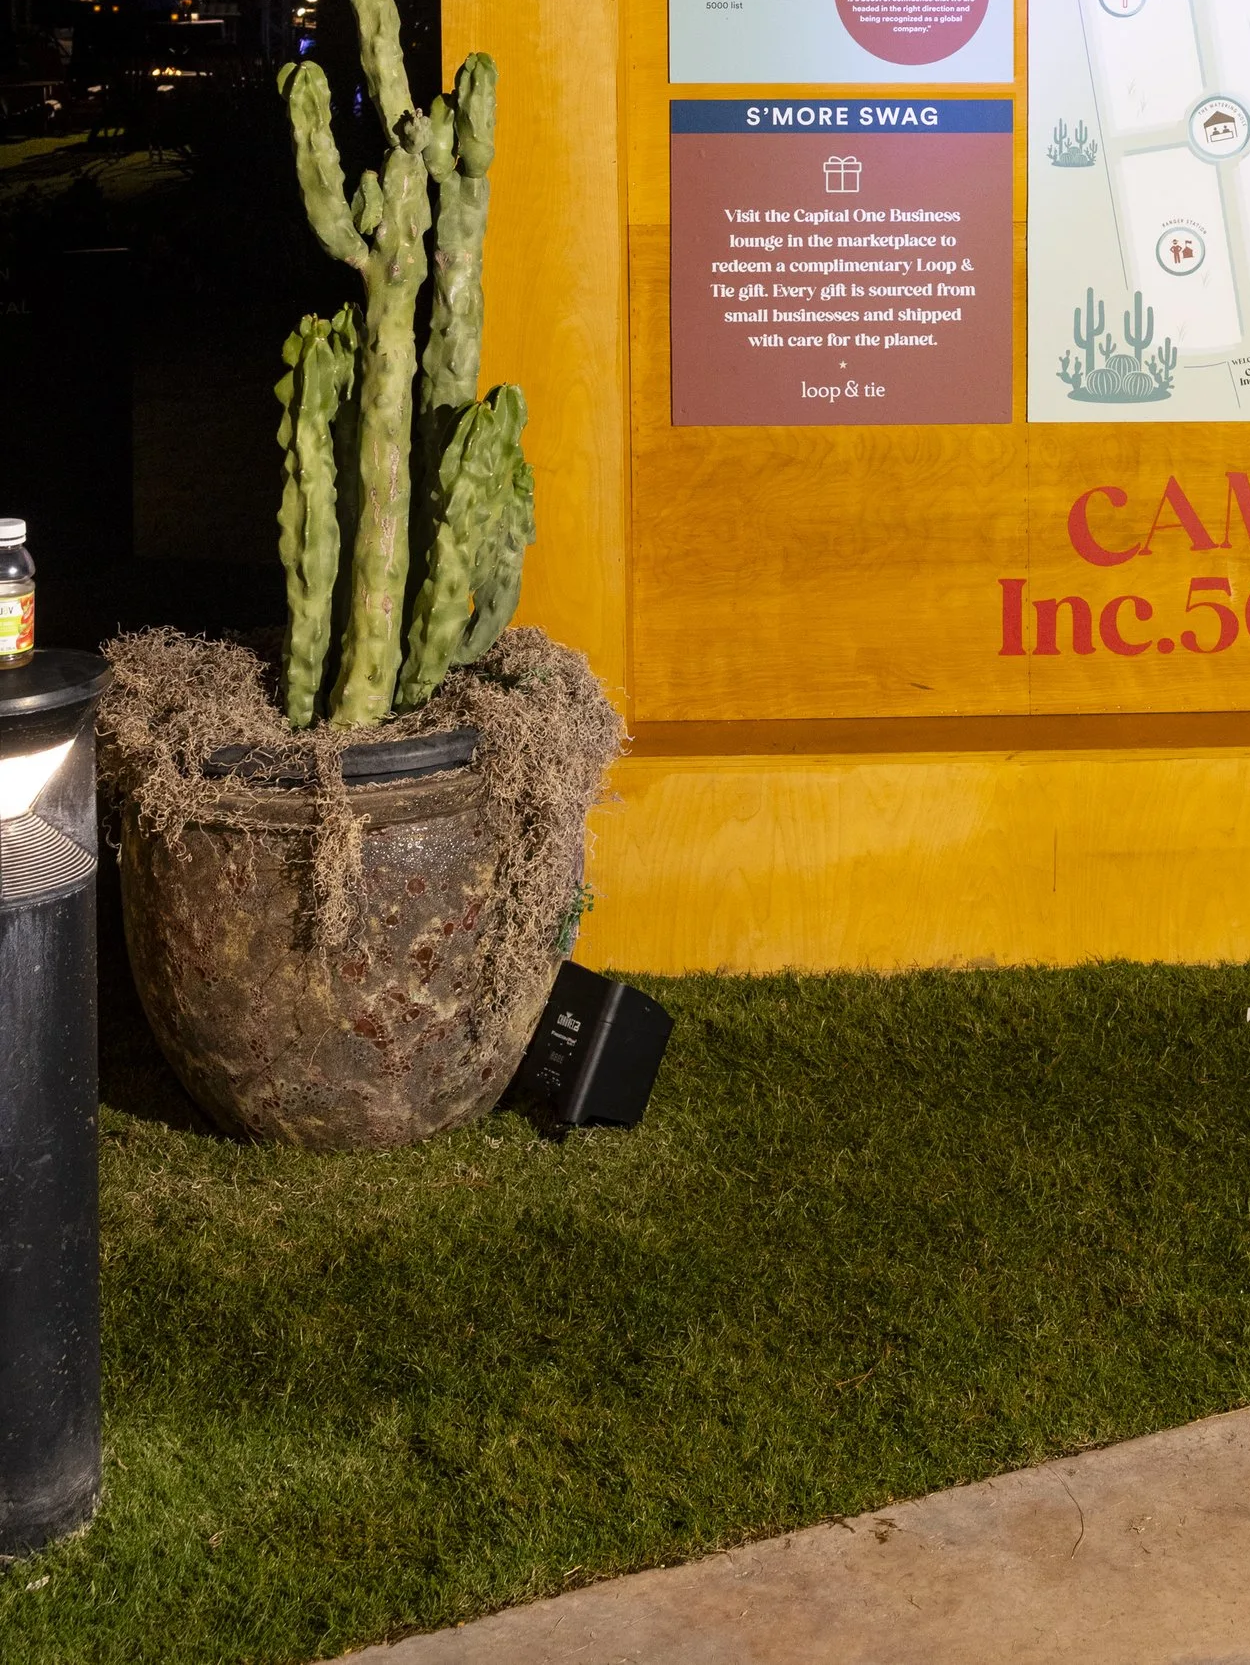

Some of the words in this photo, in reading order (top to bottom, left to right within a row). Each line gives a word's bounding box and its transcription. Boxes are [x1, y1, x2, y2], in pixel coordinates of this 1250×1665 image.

[706, 1, 729, 9] 5000
[731, 1, 743, 9] list
[859, 107, 938, 125] SWAG
[724, 209, 761, 223] Visit
[765, 209, 790, 222] the
[793, 209, 849, 225] Capital
[853, 209, 886, 222] One
[890, 209, 961, 222] Business
[730, 234, 783, 251] lounge
[787, 234, 803, 247] in
[808, 234, 833, 247] the
[837, 234, 936, 250] marketplace
[940, 235, 956, 246] to
[712, 259, 772, 273] redeem
[776, 262, 786, 272] a
[789, 259, 912, 276] complimentary
[917, 258, 957, 274] Loop
[961, 258, 974, 271] &
[710, 284, 735, 297] Tie
[738, 284, 768, 301] gift.
[773, 284, 817, 301] Every
[820, 283, 847, 301] gift
[851, 283, 865, 297] is
[868, 283, 932, 297] sourced
[937, 283, 976, 296] from
[724, 309, 768, 322] small
[773, 309, 860, 322] businesses
[863, 308, 894, 321] and
[898, 308, 962, 324] shipped
[748, 334, 784, 347] with
[788, 336, 823, 347] care
[827, 333, 851, 346] for
[855, 333, 880, 346] the
[884, 333, 938, 349] planet.
[801, 381, 841, 403] loop
[844, 380, 859, 397] &
[864, 382, 885, 397] tie
